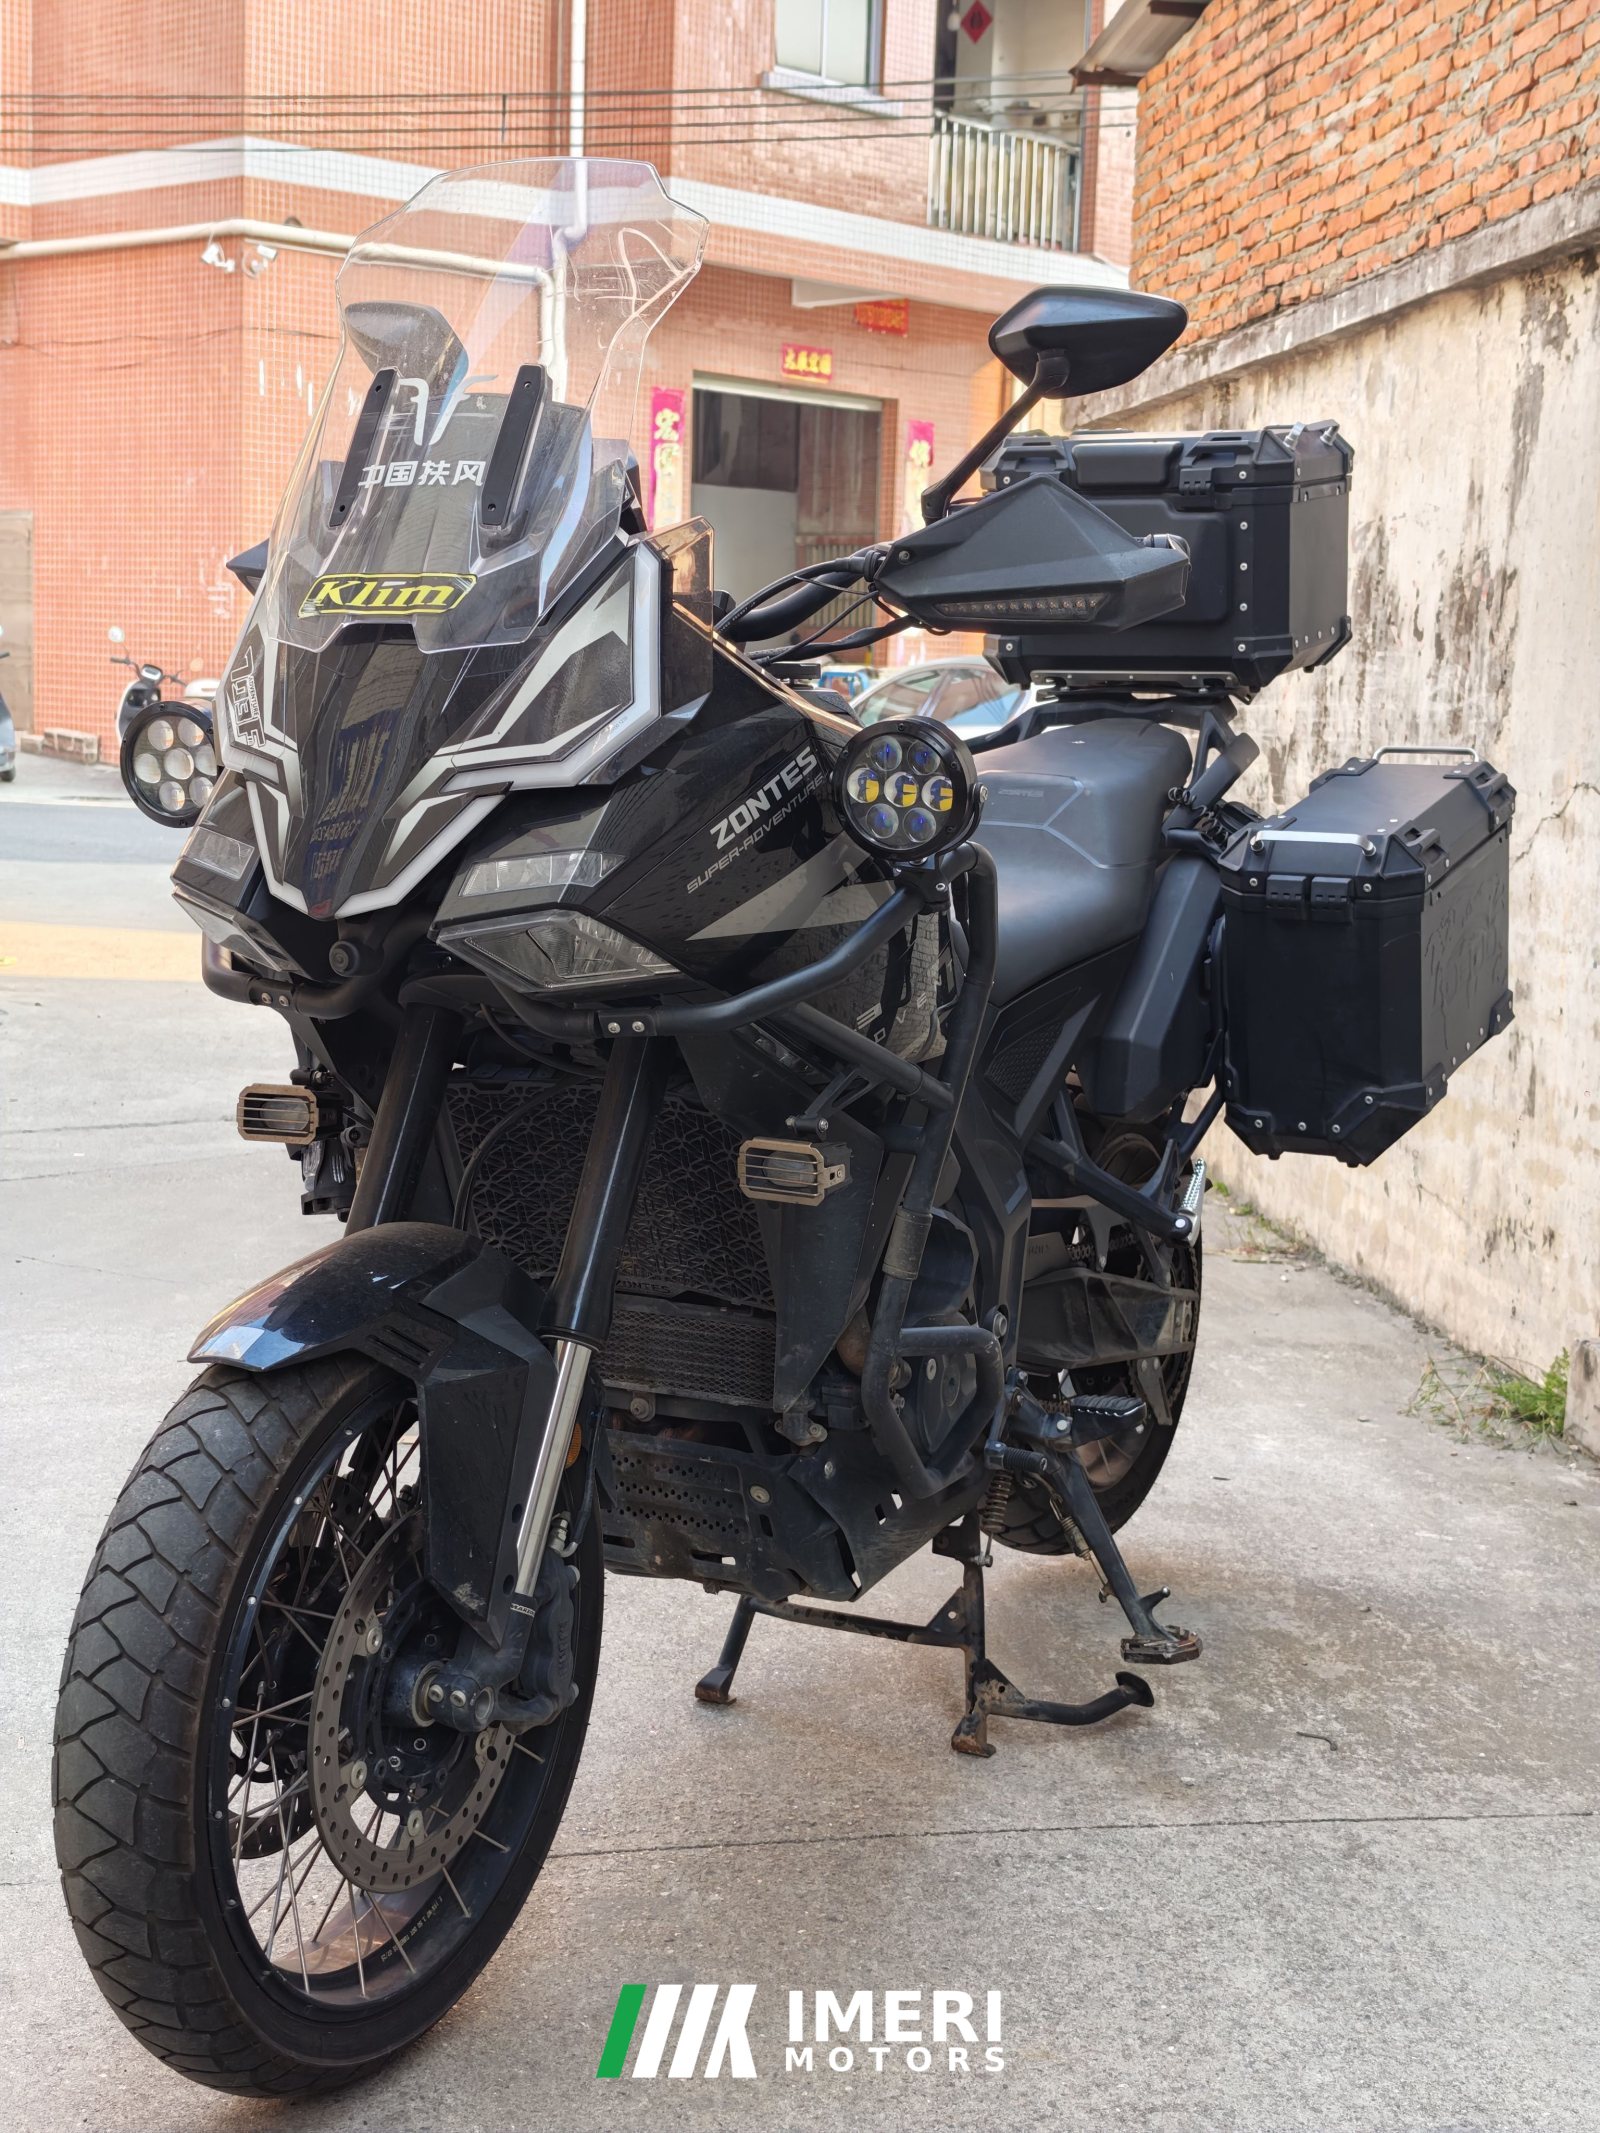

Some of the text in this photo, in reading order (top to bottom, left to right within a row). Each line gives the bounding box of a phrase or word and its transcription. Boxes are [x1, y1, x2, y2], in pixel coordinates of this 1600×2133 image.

[358, 459, 487, 489] 中国扶风
[315, 580, 455, 607] Klim
[247, 674, 261, 720] ADVENTURE
[709, 745, 819, 851] ZONTES
